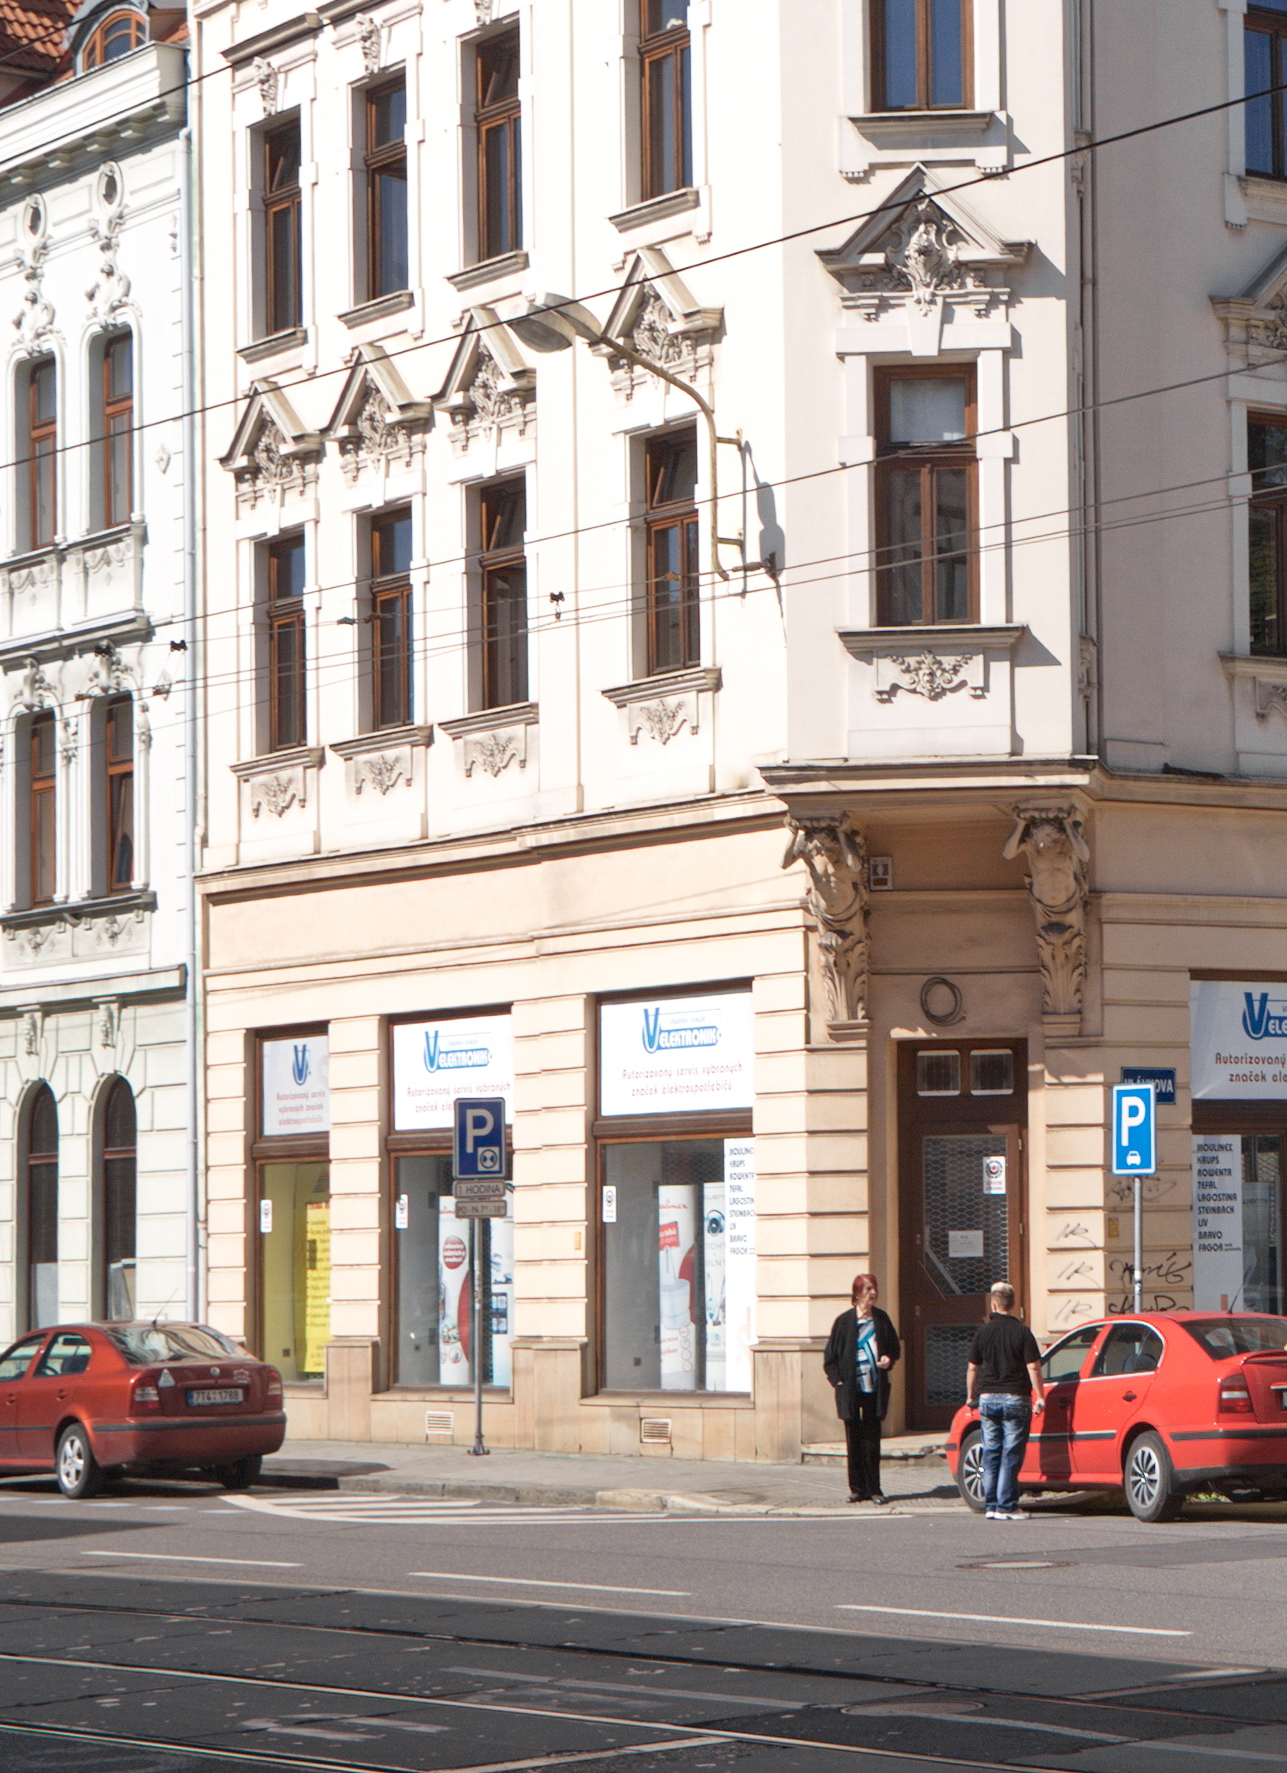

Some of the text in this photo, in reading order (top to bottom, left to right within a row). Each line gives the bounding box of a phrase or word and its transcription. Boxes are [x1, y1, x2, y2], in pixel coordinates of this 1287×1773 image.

[1215, 1052, 1286, 1068] Autorizovaný
[676, 1064, 698, 1077] servis
[1229, 1071, 1267, 1083] značek
[1121, 1095, 1146, 1147] P
[465, 1108, 494, 1154] P
[1197, 1156, 1219, 1165] KRUPS
[1197, 1168, 1232, 1177] ROWENTA
[466, 1184, 500, 1194] HODINA
[1197, 1193, 1237, 1202] LAGOSTINA
[1197, 1206, 1234, 1215] STEINBACH
[1198, 1243, 1223, 1252] FAGOR
